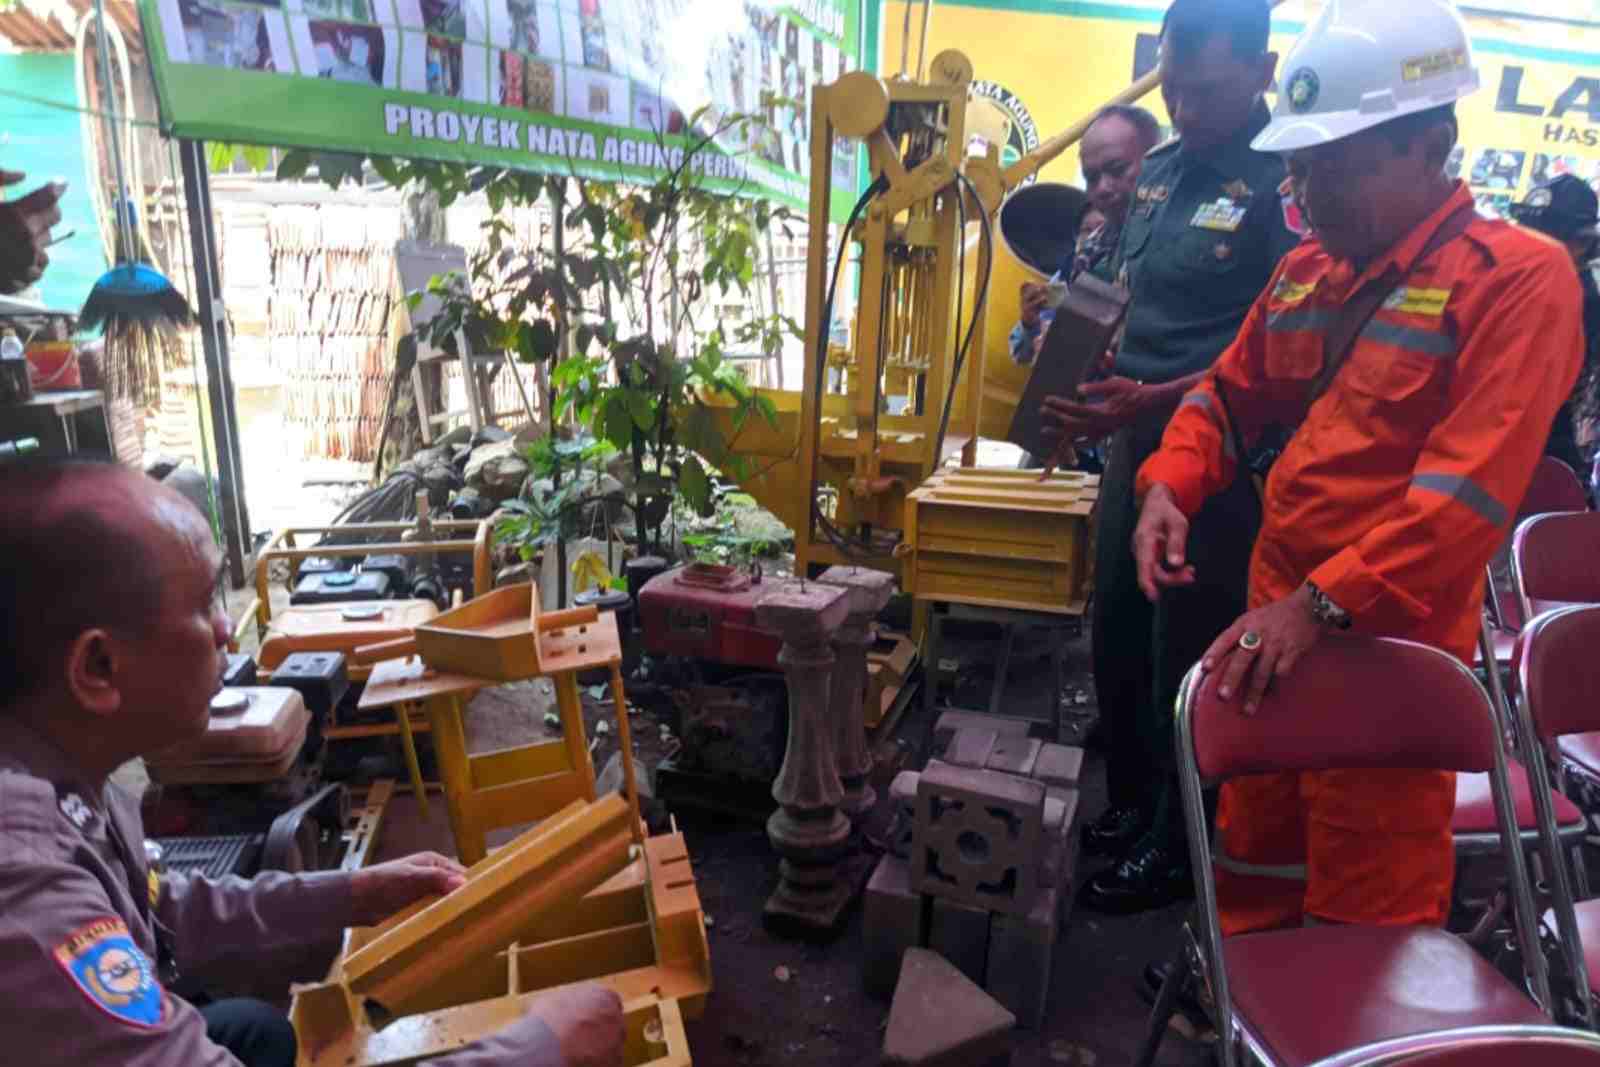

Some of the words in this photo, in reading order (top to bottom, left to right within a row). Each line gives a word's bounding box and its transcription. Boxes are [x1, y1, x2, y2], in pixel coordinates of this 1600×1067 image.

[384, 103, 522, 150] PROYEK
[527, 124, 597, 161] NATA
[603, 136, 685, 171] AGUNG
[690, 152, 748, 181] PERW
[1543, 123, 1599, 146] HAS
